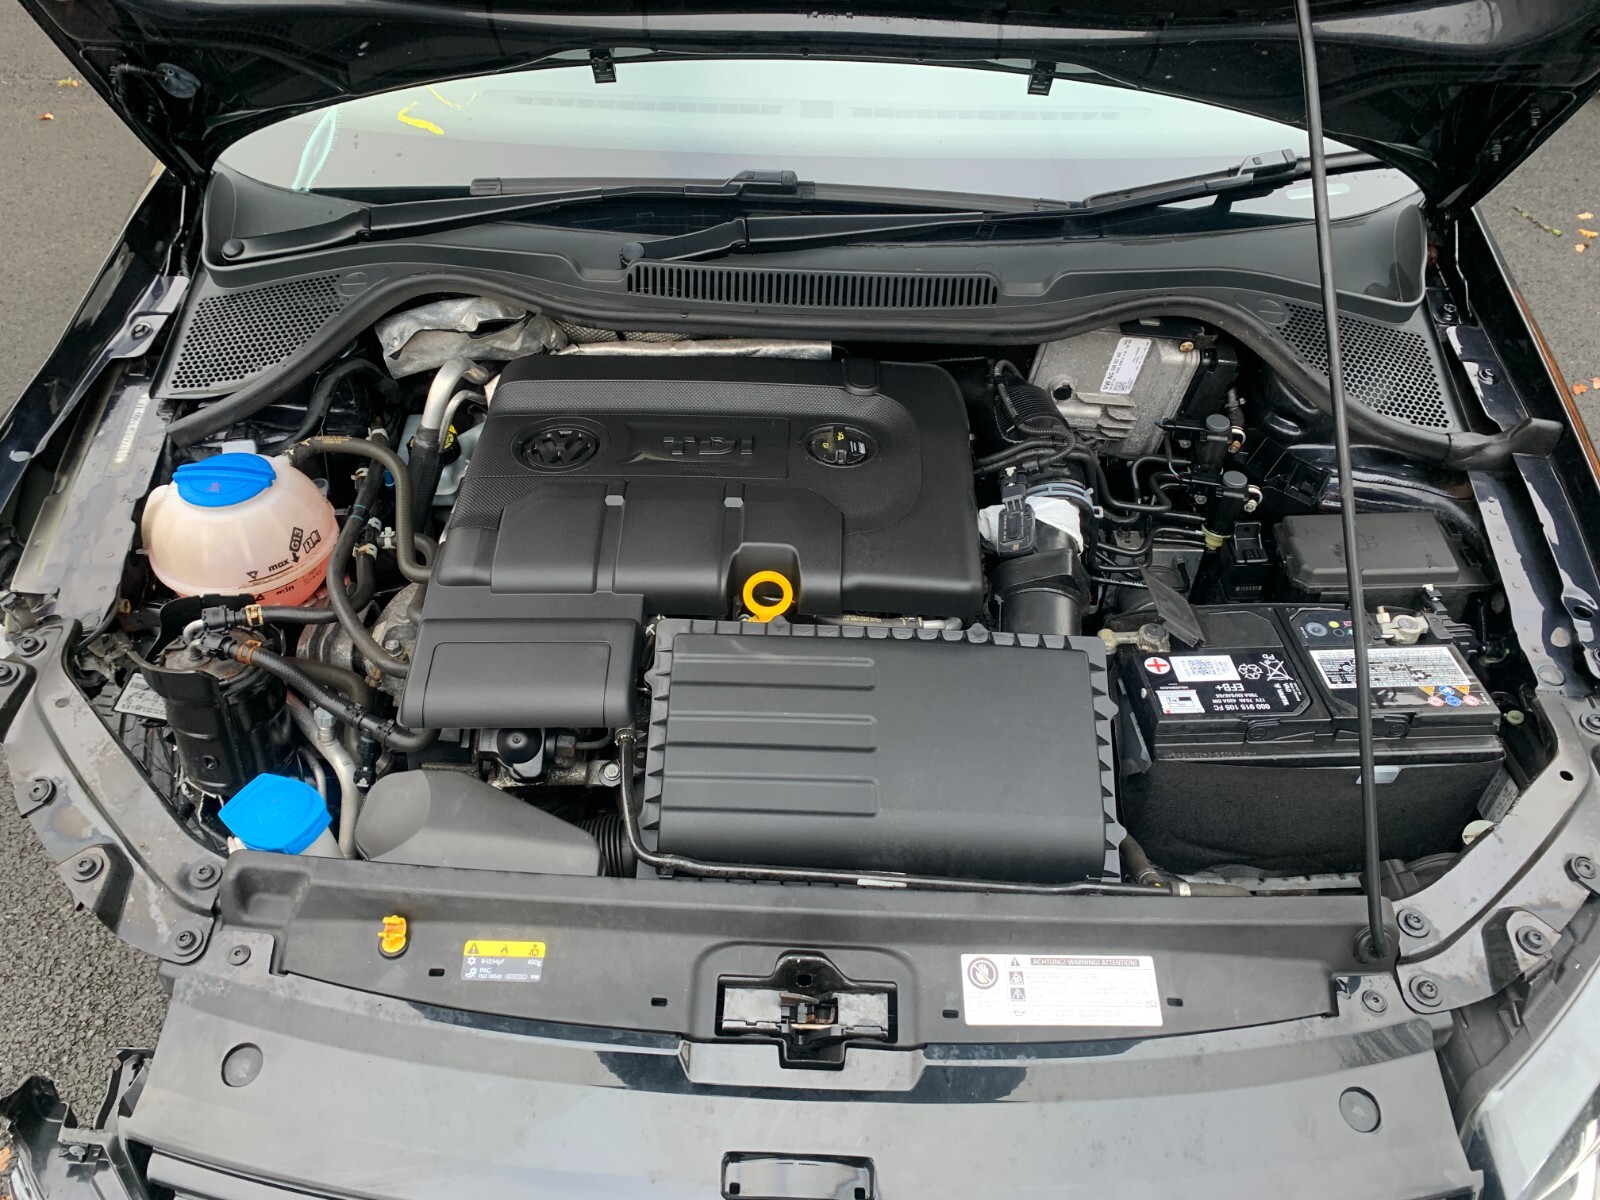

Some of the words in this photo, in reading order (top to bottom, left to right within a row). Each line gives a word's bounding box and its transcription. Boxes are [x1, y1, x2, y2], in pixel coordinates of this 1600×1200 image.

[663, 435, 755, 456] TDI
[291, 530, 302, 549] G13
[268, 558, 290, 572] max
[276, 585, 295, 595] min
[1215, 683, 1245, 692] EFB+
[1033, 958, 1067, 966] ACHTUNG!
[1067, 959, 1100, 967] WARNING!
[1101, 959, 1138, 967] ATTENTION!
